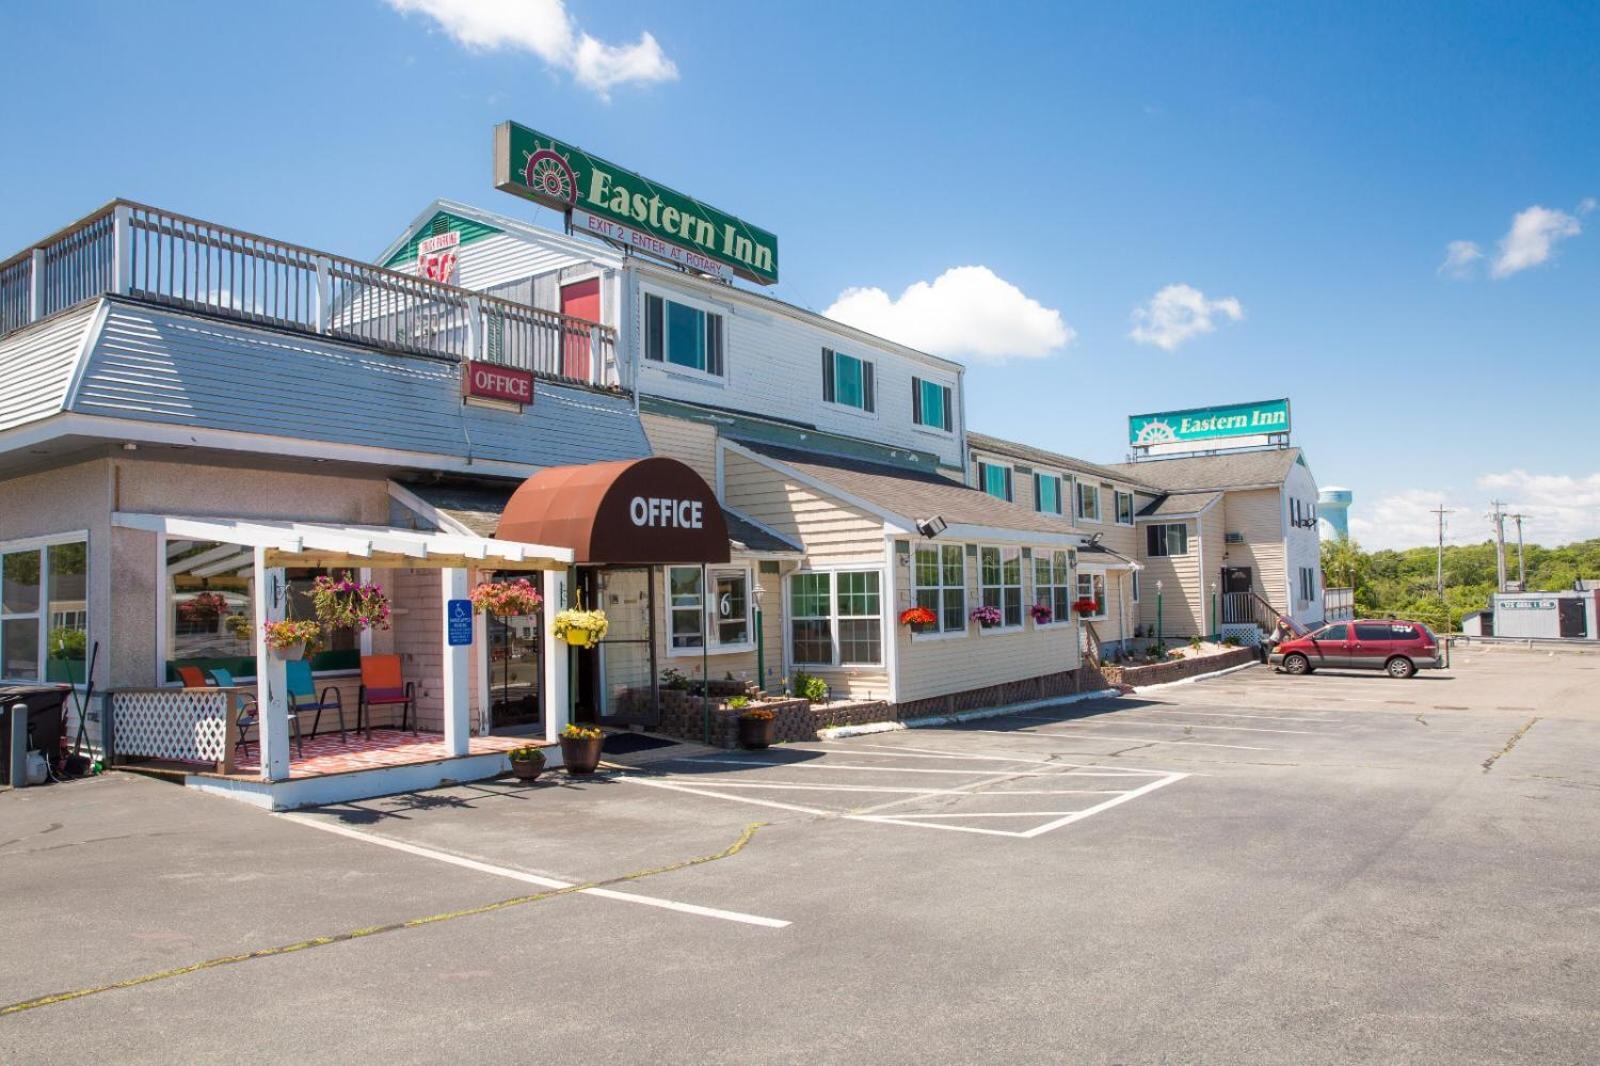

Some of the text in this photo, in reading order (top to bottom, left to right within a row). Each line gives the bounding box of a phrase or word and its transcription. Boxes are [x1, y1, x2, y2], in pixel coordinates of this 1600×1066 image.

[587, 167, 773, 273] Eastern Inn
[588, 217, 722, 276] EXIT 2 ENTER AT ROTARY
[475, 370, 529, 397] OFFICE
[1180, 410, 1286, 433] Eastern Inn
[630, 496, 703, 529] OFFICE
[720, 592, 731, 616] 6
